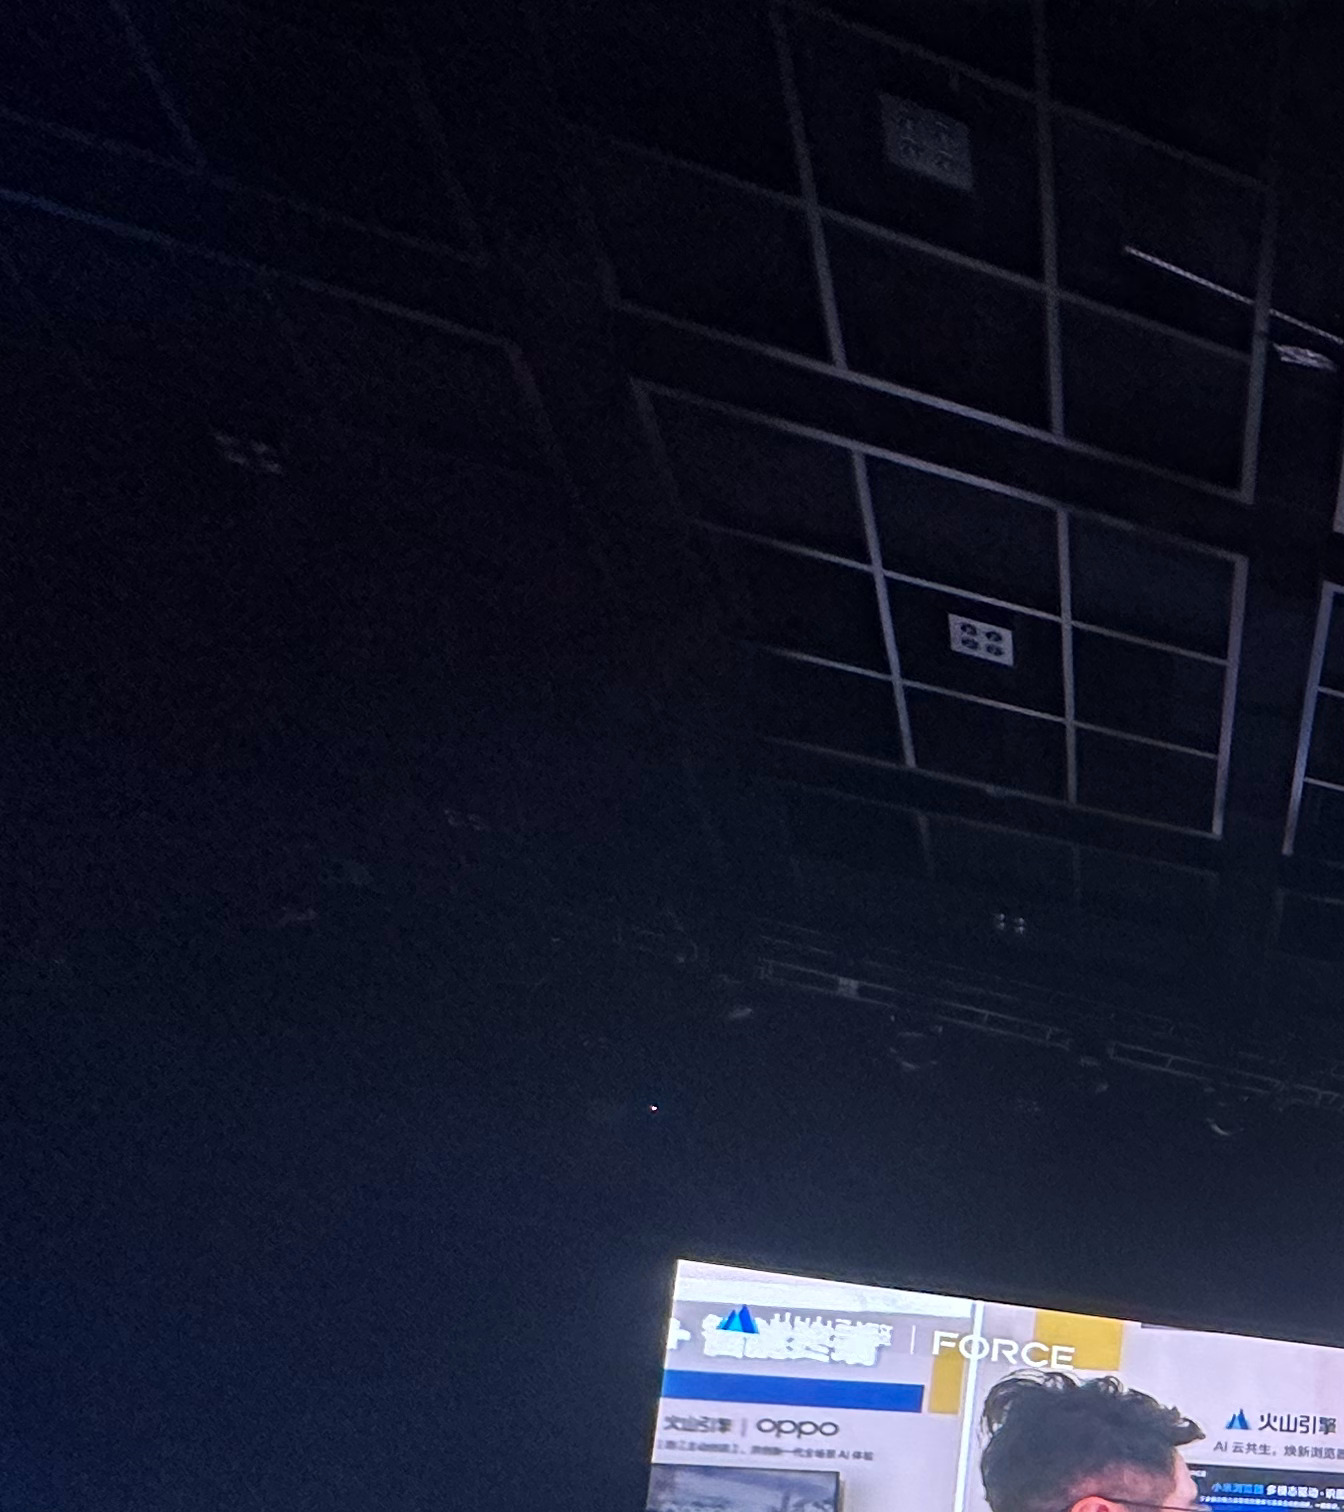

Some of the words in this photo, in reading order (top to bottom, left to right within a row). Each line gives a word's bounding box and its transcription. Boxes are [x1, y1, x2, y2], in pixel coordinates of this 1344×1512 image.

[931, 1330, 1076, 1370] FORCE
[1258, 1412, 1337, 1435] 火山引擎
